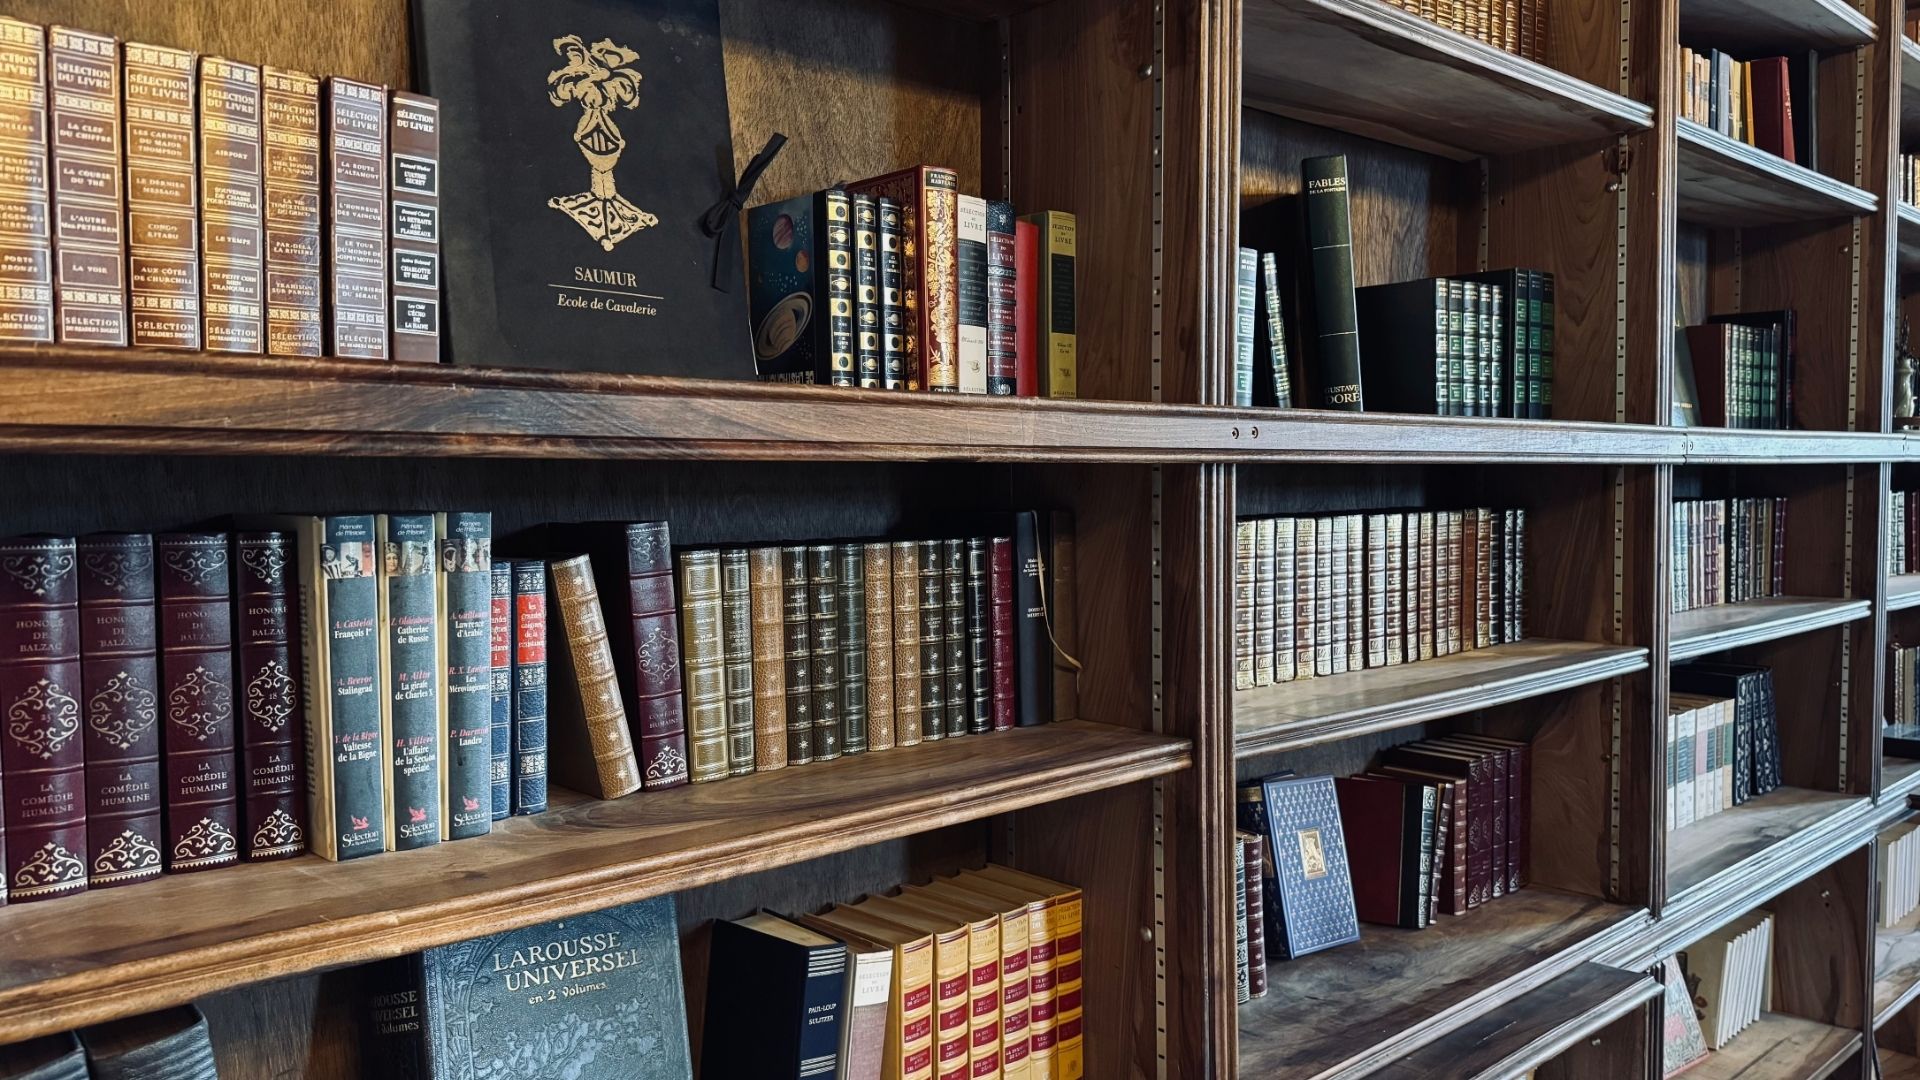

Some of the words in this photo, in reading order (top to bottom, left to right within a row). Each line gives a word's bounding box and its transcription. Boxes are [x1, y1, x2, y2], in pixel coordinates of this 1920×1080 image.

[57, 62, 111, 80] SÉLECTION
[57, 72, 75, 83] DU
[77, 76, 111, 89] LIVRE
[130, 73, 188, 90] SÉLECTION
[130, 84, 148, 94] DU
[152, 87, 188, 100] LIVRE
[206, 88, 255, 105] SÉLECTION
[207, 98, 222, 107] DU
[226, 101, 254, 114] LIVRE
[287, 114, 315, 125] LIVRE
[396, 110, 434, 124] SÉLECTION
[67, 122, 79, 130] LA
[336, 117, 349, 126] DU
[352, 119, 378, 131] LIVRE
[396, 119, 409, 127] DU
[410, 121, 434, 133] LIVRE
[215, 149, 248, 160] AIRPORT
[63, 167, 75, 175] LA
[1308, 177, 1346, 188] FABLES
[72, 264, 84, 272] LA
[140, 266, 159, 274] AUX
[574, 266, 638, 288] SAUMUR
[557, 293, 588, 309] Ecole
[590, 298, 604, 309] de
[606, 299, 657, 316] Cavalerie
[65, 316, 119, 327] SÉLECTION
[137, 321, 195, 332] SÉLECTION
[209, 327, 257, 337] SÉLECTION
[397, 625, 430, 635] Catherine
[455, 620, 484, 629] Lawrence
[33, 632, 48, 640] DE
[252, 628, 287, 637] BALZAC
[334, 629, 364, 639] François
[456, 629, 483, 638] d'Arabie
[397, 636, 407, 644] de
[408, 635, 430, 643] Russie
[20, 643, 62, 653] BALZAC
[337, 684, 373, 696] Stalingrad
[401, 682, 409, 691] La
[410, 680, 429, 691] girafe
[395, 692, 404, 700] de
[405, 690, 428, 699] Charles
[343, 741, 372, 752] Valtesse
[460, 737, 483, 747] Landru
[338, 753, 347, 762] de
[349, 752, 357, 761] la
[358, 750, 377, 761] Bigne
[403, 745, 429, 756] L'affaire
[269, 755, 281, 763] LA
[395, 757, 404, 766] de
[406, 756, 413, 764] la
[414, 754, 436, 764] Section
[198, 762, 211, 771] LA
[403, 764, 430, 776] spéciale
[119, 773, 132, 781] LA
[180, 771, 228, 784] COMÉDIE
[40, 783, 54, 792] LA
[101, 782, 150, 795] COMÉDIE
[181, 782, 228, 795] HUMAINE
[21, 792, 74, 806] COMÉDIE
[101, 793, 151, 806] HUMAINE
[22, 804, 74, 818] HUMAINE
[400, 822, 435, 838] Sélection
[342, 830, 379, 848] Sélection
[493, 932, 622, 972] LAROUSSE
[505, 949, 643, 991] UNIVERSEL
[528, 993, 543, 1005] en
[547, 989, 557, 1001] 2
[808, 1003, 837, 1014] PAUL-LOUP
[808, 1015, 834, 1025] SULITZER
